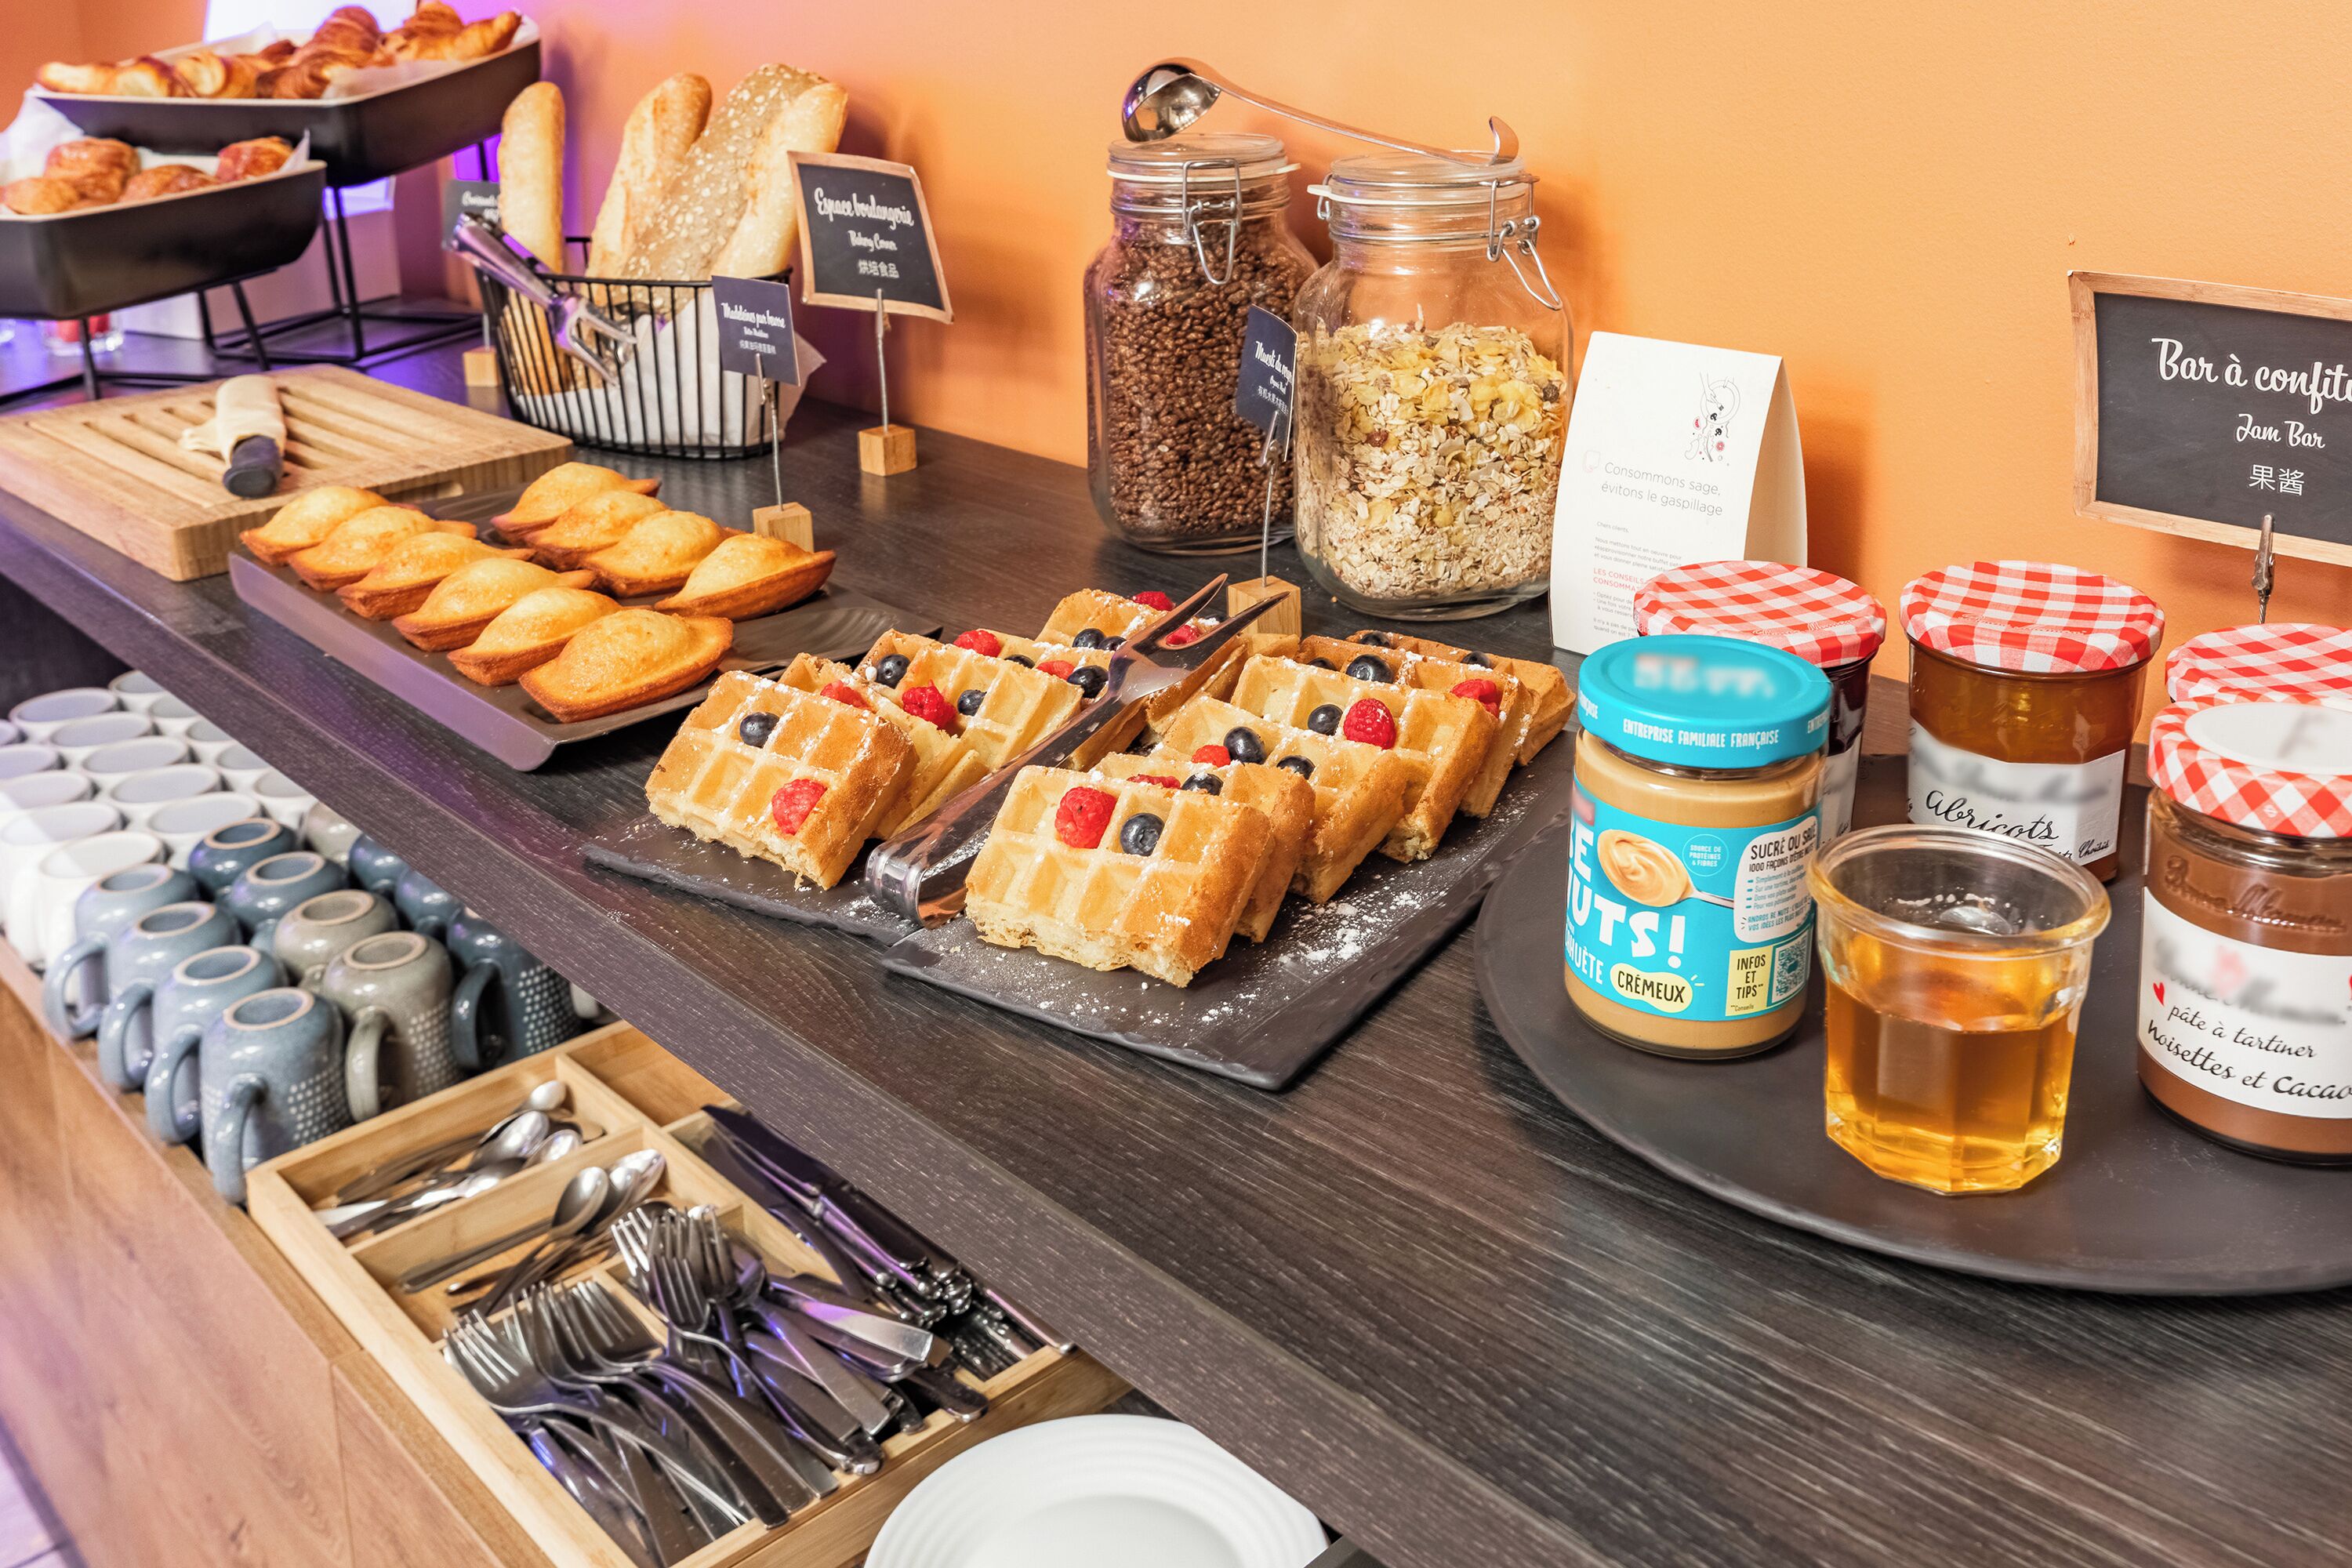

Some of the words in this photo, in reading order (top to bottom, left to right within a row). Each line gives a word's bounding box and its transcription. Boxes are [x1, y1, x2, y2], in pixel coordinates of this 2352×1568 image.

[814, 187, 855, 222] Espace
[852, 193, 914, 230] boulangerie
[1255, 340, 1276, 368] Muesli
[1275, 354, 1282, 372] du
[2151, 338, 2219, 383] Bar
[2224, 354, 2248, 387] à
[2237, 413, 2281, 442] Jam
[2285, 420, 2325, 449] Bar
[1604, 462, 1686, 488] Consommons
[2249, 464, 2305, 496] 果酱
[1601, 481, 1643, 500] évitons
[1646, 489, 1657, 503] le
[1661, 495, 1723, 517] gaspillage
[1593, 568, 1606, 576] LES
[1608, 571, 1644, 585] CONSEILS
[1593, 576, 1641, 591] CONSOMMA
[1623, 718, 1674, 744] ENTREPRISE
[1678, 730, 1726, 748] FAMILIALE
[1730, 728, 1780, 750] FRANÇAISE
[1751, 837, 1785, 861] SUCRÉ
[1788, 833, 1801, 851] OU
[1748, 862, 1765, 873] 1000
[1766, 855, 1788, 872] FAÇONS
[1737, 954, 1766, 971] INFOS
[1745, 971, 1757, 984] ET
[1617, 970, 1686, 1004] CRÉMEUX
[2167, 1004, 2208, 1032] pâte
[2212, 1021, 2227, 1039] à
[2233, 1027, 2318, 1059] tartiner
[2242, 1071, 2267, 1089] et
